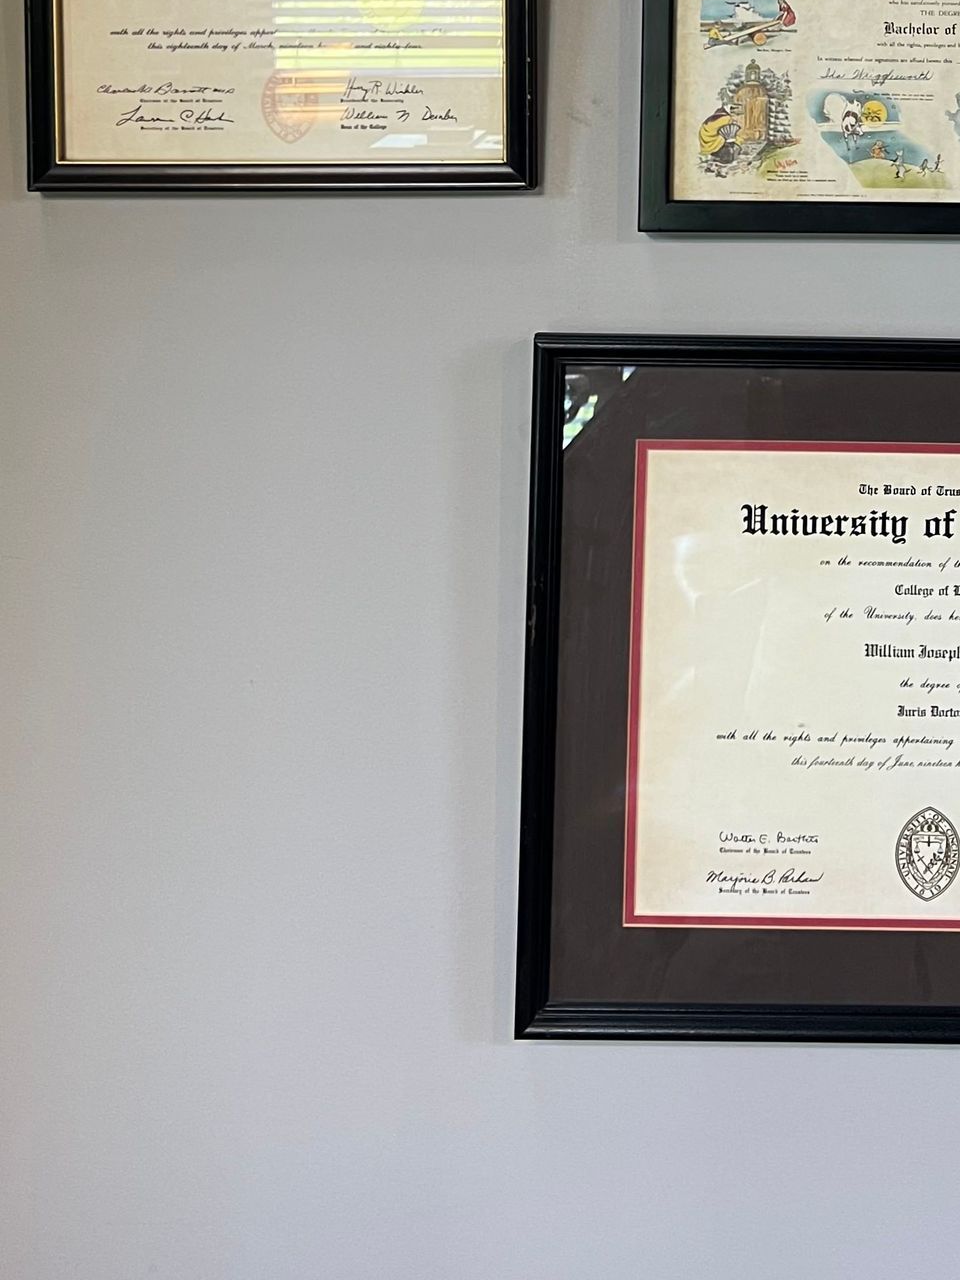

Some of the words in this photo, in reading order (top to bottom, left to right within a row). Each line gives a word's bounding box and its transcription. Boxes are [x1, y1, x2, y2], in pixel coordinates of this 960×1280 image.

[163, 29, 186, 38] rights
[884, 21, 939, 37] Bachelor
[945, 24, 957, 35] of
[859, 484, 878, 496] The
[883, 485, 916, 495] Board
[921, 486, 931, 496] of
[741, 504, 908, 544] University
[923, 509, 957, 539] of
[838, 555, 851, 566] the
[858, 557, 932, 568] recommendation
[939, 557, 951, 572] of
[895, 584, 934, 598] College
[939, 585, 949, 596] of
[865, 643, 915, 658] William
[900, 678, 914, 688] the
[921, 678, 950, 694] degree
[897, 705, 926, 717] Juris
[716, 729, 737, 740] with
[743, 730, 759, 740] all
[763, 731, 776, 741] the
[784, 731, 811, 747] rights
[817, 732, 838, 743] and
[840, 733, 886, 749] privileges
[893, 733, 953, 750] appertaining
[719, 831, 755, 842] Walter
[760, 834, 770, 844] E.
[706, 871, 759, 889] Marjorie
